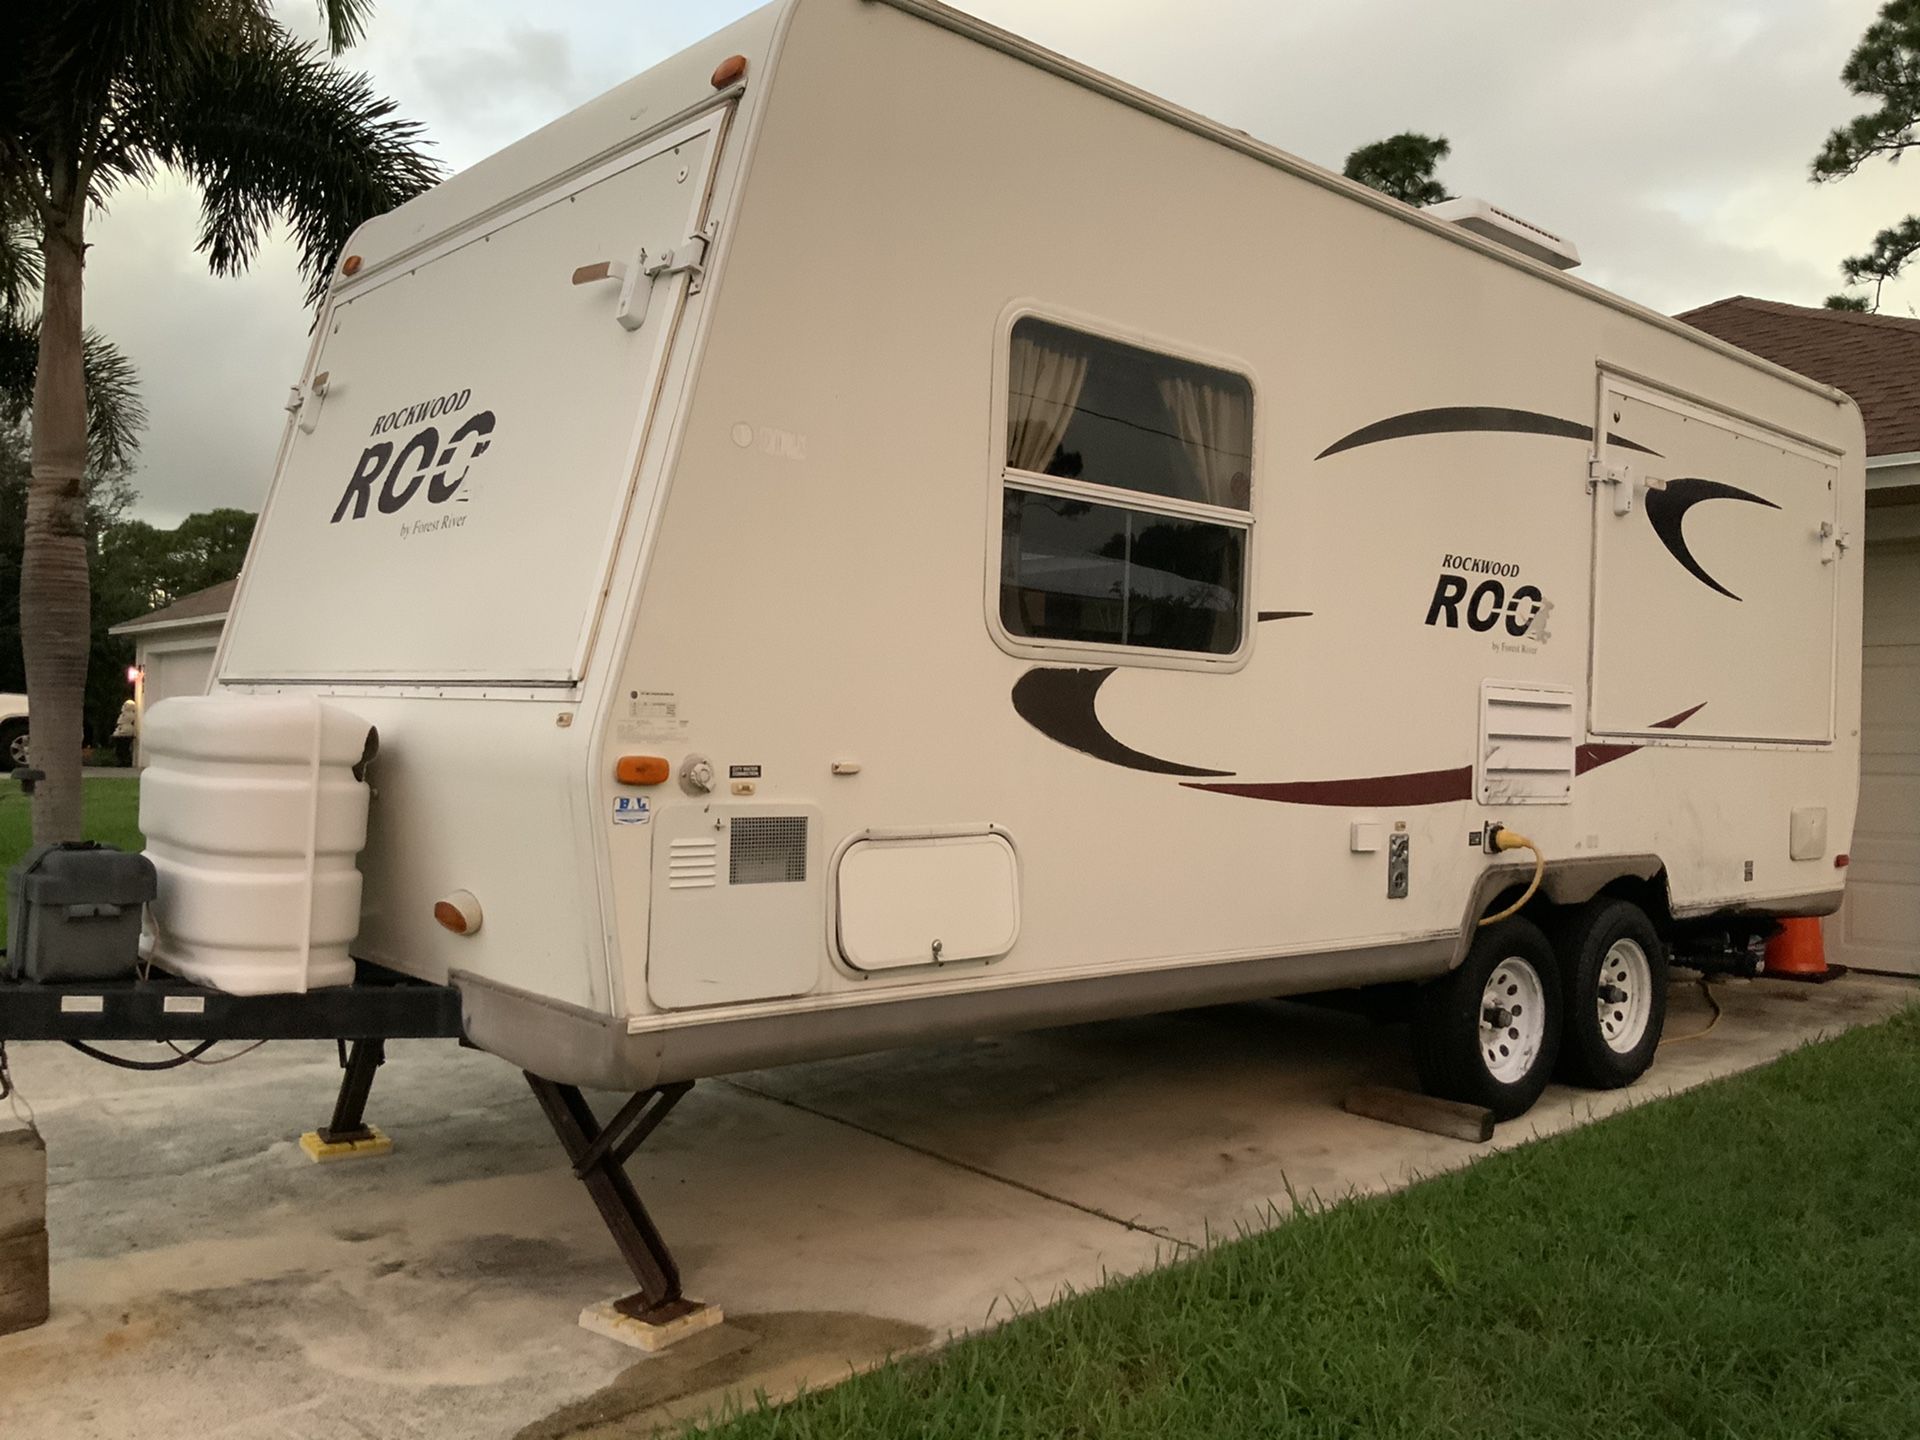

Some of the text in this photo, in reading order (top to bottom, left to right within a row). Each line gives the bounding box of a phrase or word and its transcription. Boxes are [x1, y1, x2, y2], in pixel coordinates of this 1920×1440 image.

[370, 388, 471, 437] ROCKWOOD
[330, 410, 496, 524] ROO
[400, 514, 468, 540] by Forest River
[1442, 553, 1520, 578] ROCKWOOD
[1424, 574, 1542, 637] ROO
[1491, 640, 1500, 654] by
